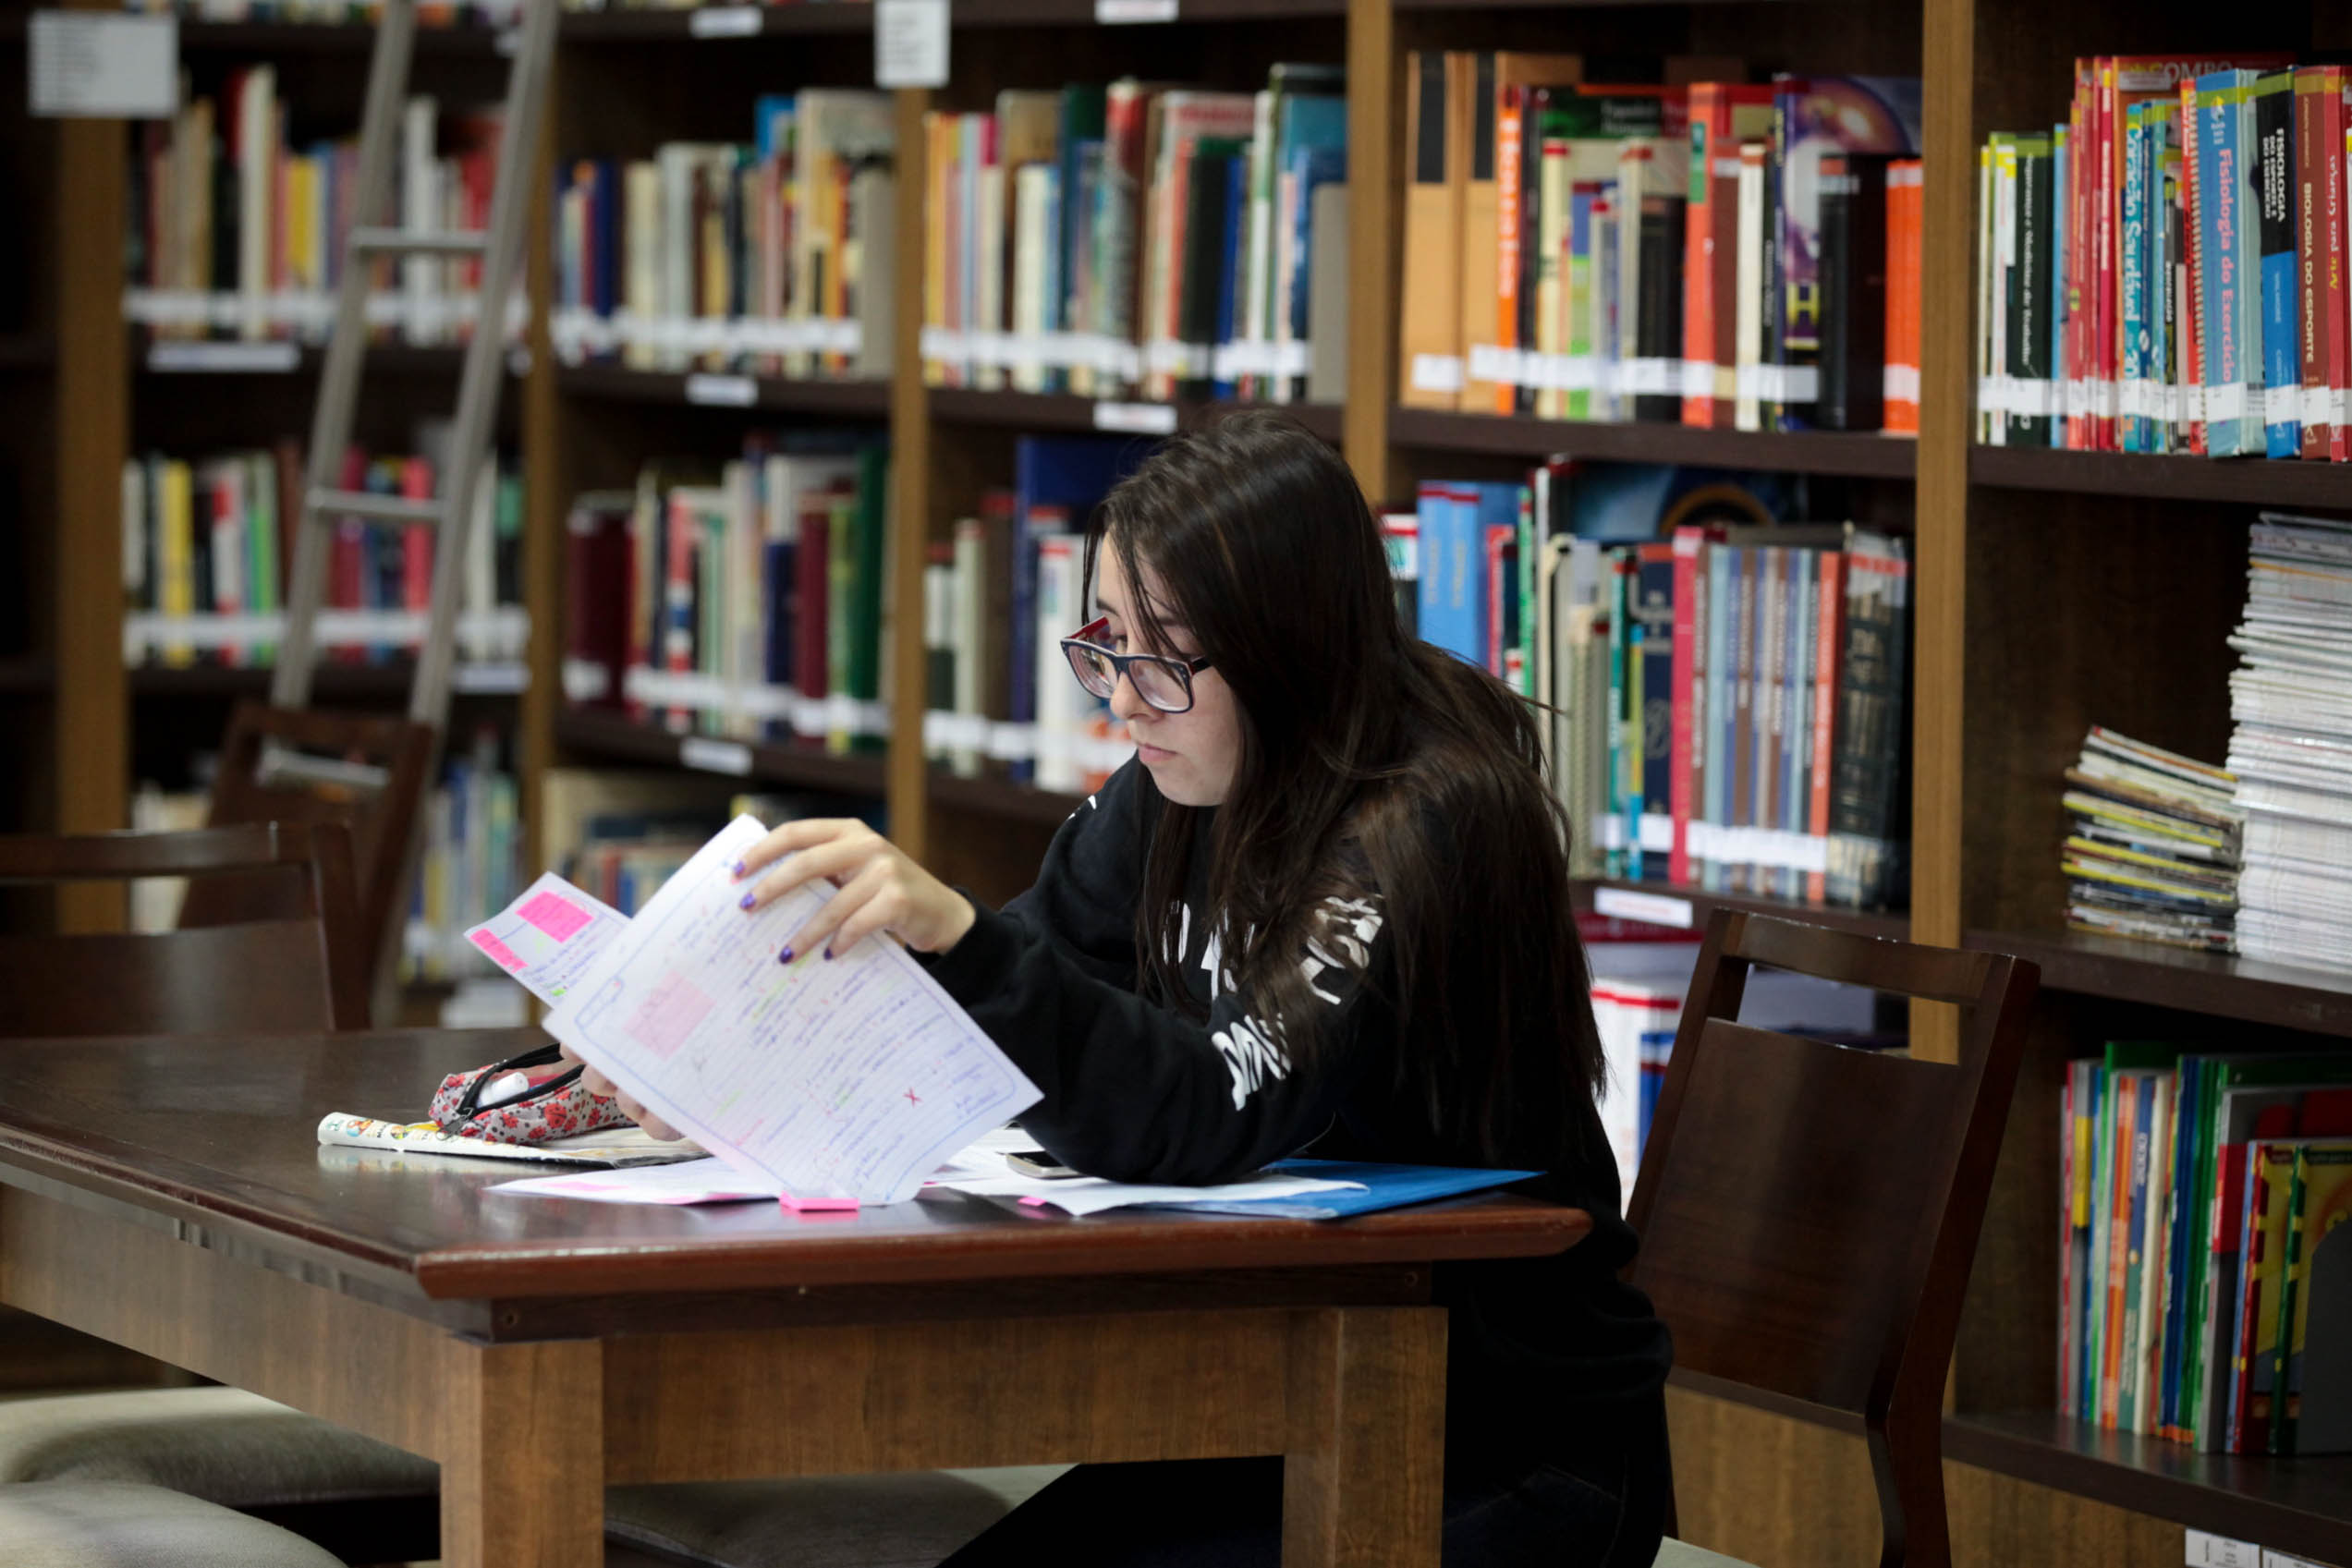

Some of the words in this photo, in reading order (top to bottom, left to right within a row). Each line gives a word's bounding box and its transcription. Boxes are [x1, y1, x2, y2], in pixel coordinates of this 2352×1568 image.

[2125, 123, 2143, 216] Coração
[2217, 148, 2234, 250] Fisiologia
[2276, 128, 2285, 223] FISIOLOGIA
[2328, 154, 2338, 217] Crianças
[2303, 182, 2312, 258] BIOLOGIA
[2330, 221, 2338, 252] para
[2125, 221, 2142, 322] Saudável
[2222, 256, 2234, 284] do
[2304, 261, 2313, 286] DO
[2329, 257, 2338, 289] Arte
[2223, 288, 2235, 383] Exercício
[2305, 287, 2314, 363] ESPORTE
